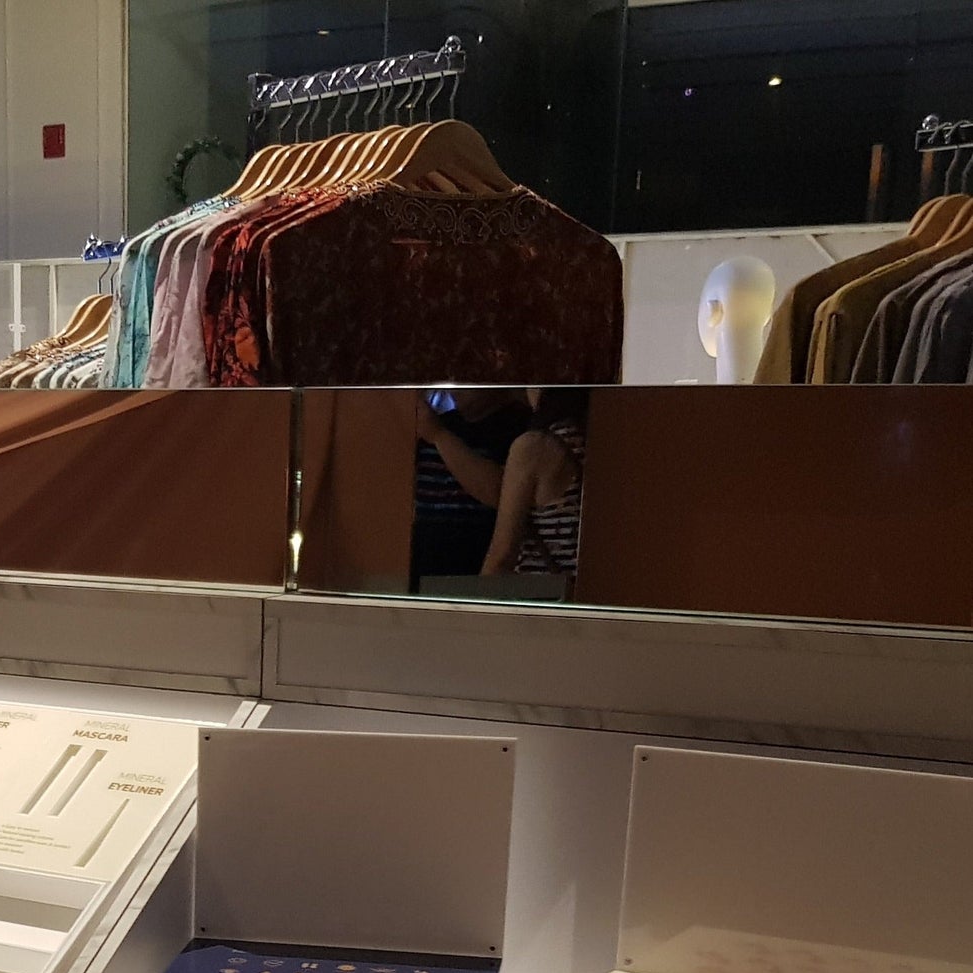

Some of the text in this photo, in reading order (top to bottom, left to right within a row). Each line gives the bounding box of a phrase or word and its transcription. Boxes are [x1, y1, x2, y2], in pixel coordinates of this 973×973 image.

[83, 719, 132, 732] MINERAL
[72, 729, 130, 743] MASCARA
[119, 772, 169, 785] MINERAL
[108, 782, 165, 797] EYELINER
